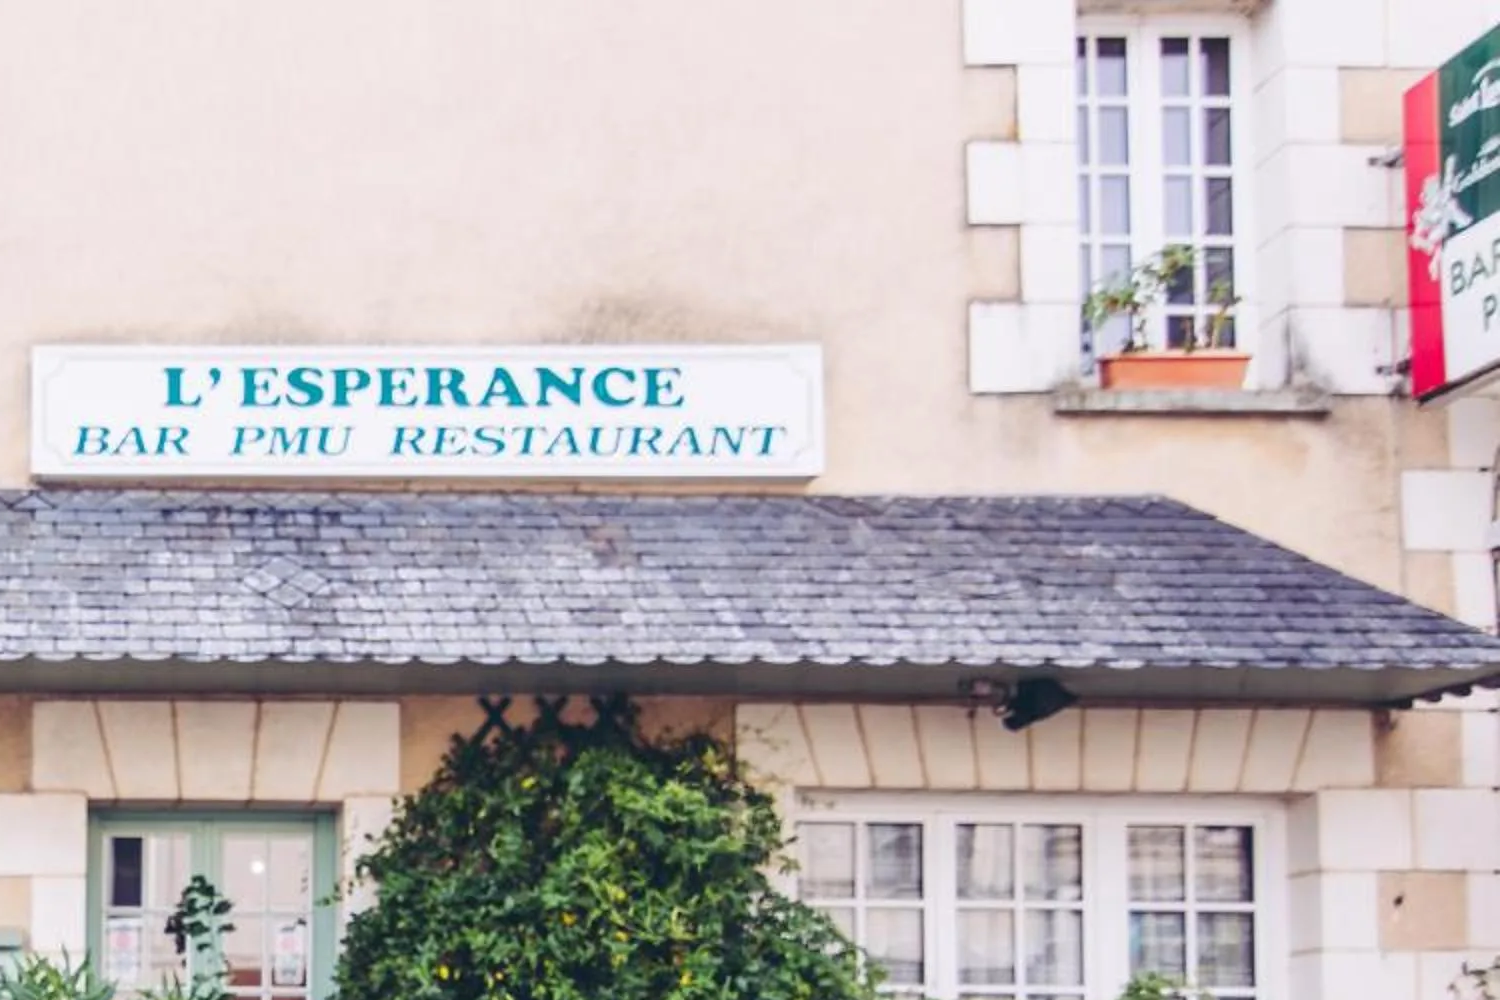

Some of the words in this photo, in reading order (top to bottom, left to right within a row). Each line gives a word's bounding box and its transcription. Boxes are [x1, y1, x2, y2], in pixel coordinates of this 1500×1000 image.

[163, 367, 685, 408] L'ESPERANCE
[73, 425, 190, 457] BAR
[228, 425, 353, 457] PMU
[388, 425, 788, 457] RESTAURANT
